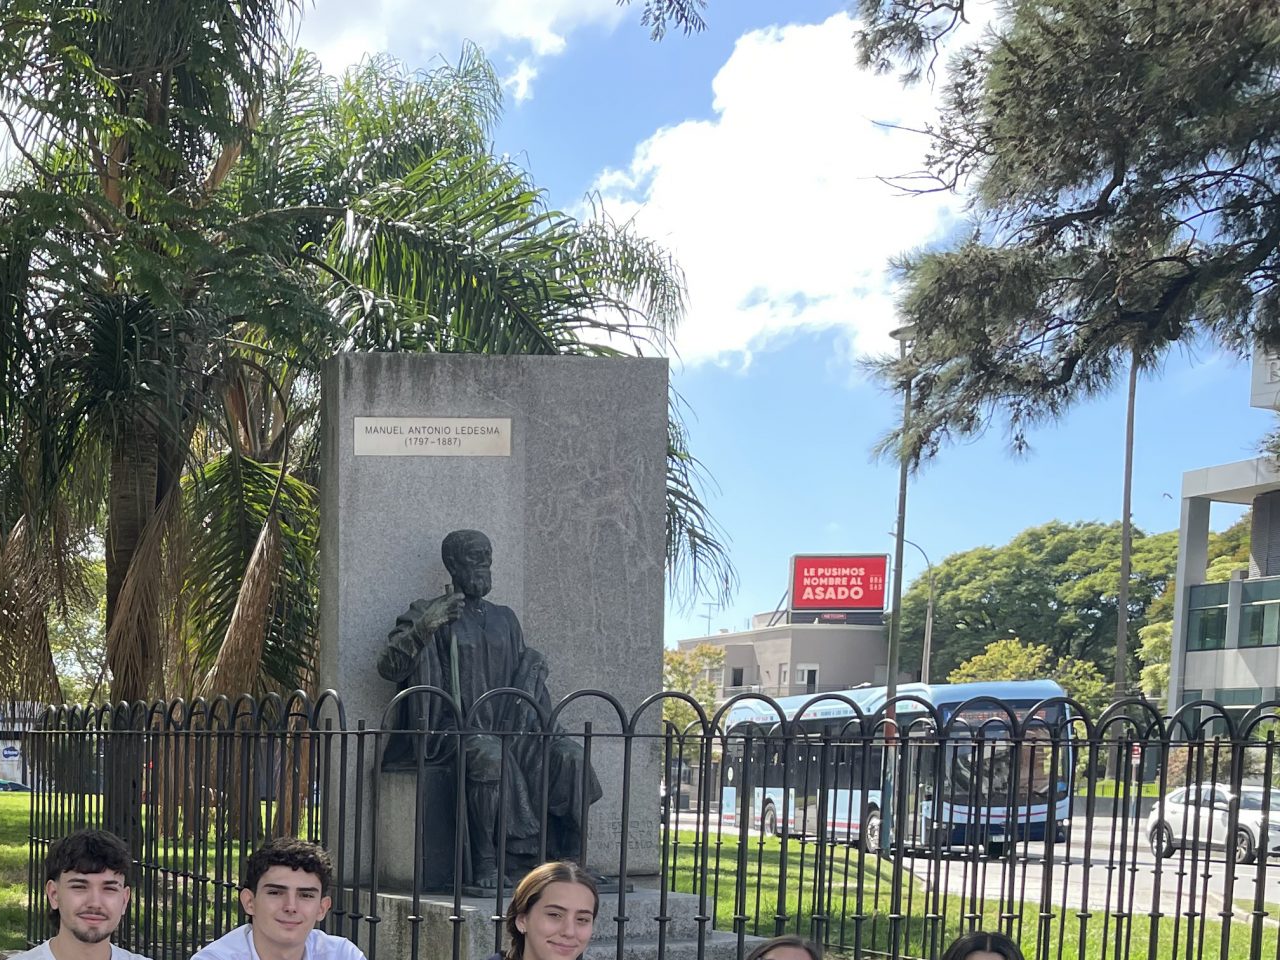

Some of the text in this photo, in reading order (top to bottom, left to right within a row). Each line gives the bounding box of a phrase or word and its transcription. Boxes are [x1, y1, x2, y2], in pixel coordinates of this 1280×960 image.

[365, 426, 500, 435] MANUEL ANTONIO LEDESMA
[803, 567, 865, 577] LE PUSIMOS
[803, 577, 863, 586] NOMBRE AL
[802, 586, 864, 600] ASADO
